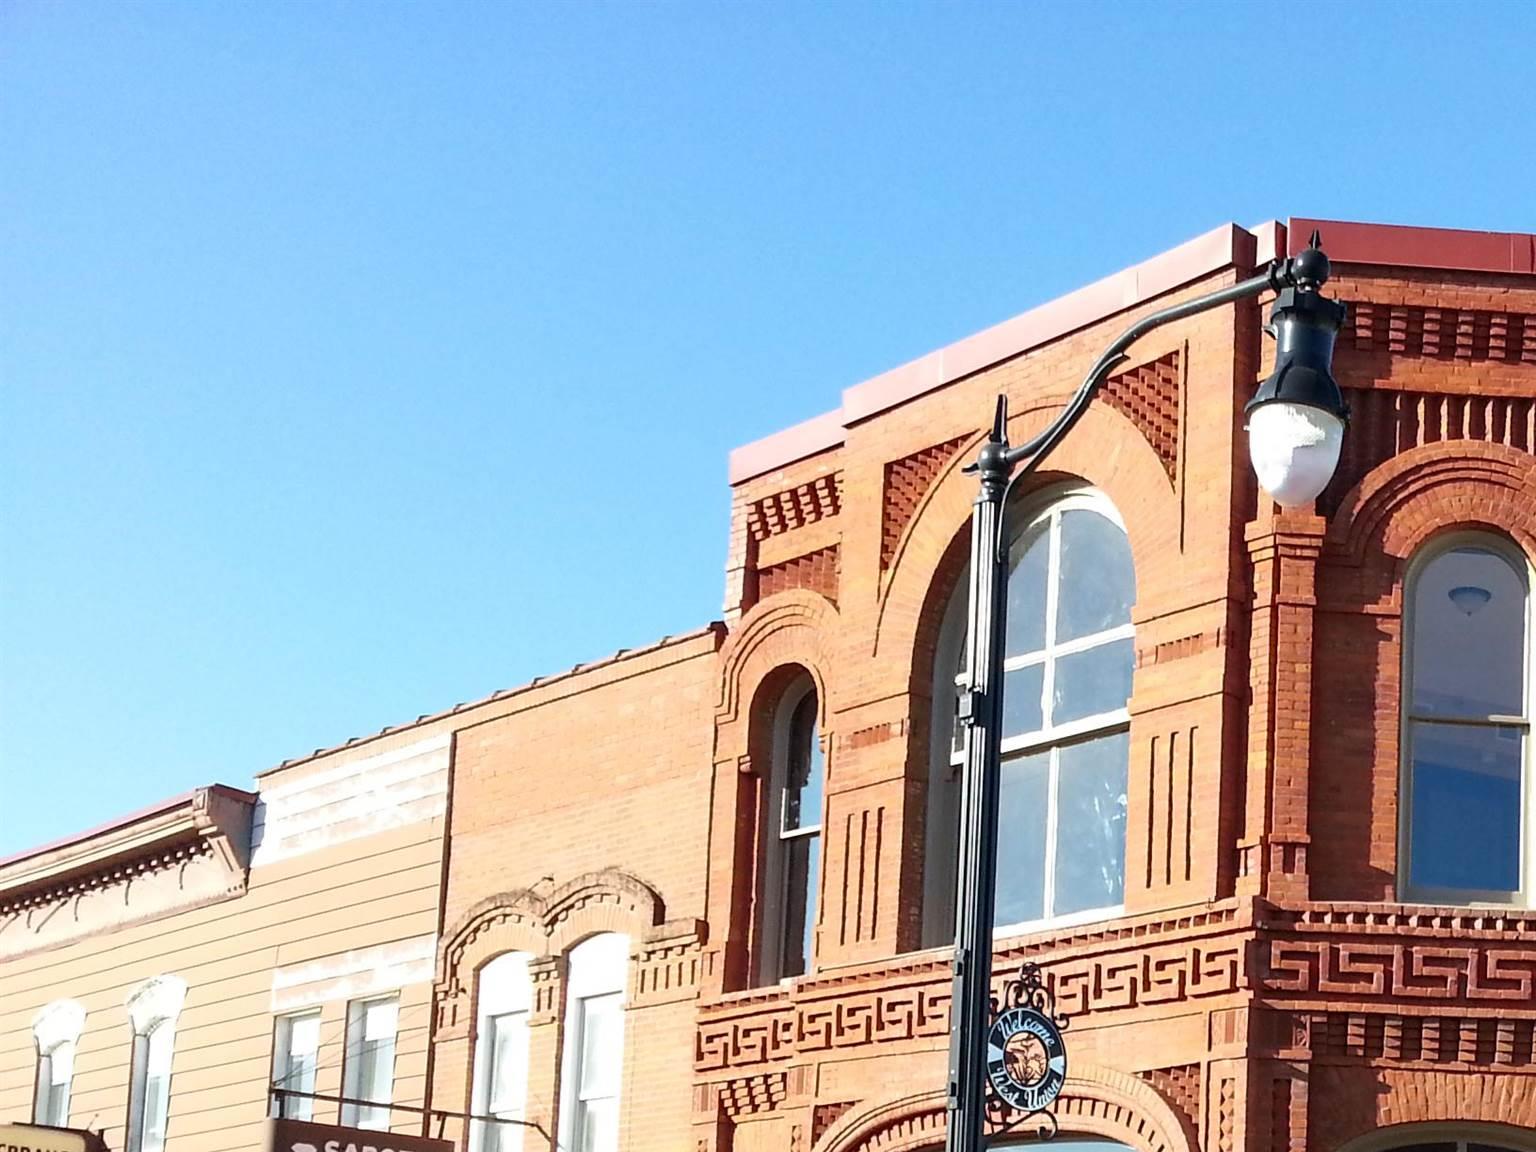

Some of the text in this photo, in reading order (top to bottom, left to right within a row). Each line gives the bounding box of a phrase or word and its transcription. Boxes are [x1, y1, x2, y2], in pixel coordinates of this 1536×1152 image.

[997, 1009, 1055, 1047] Welcome
[991, 1067, 1060, 1110] West Union
